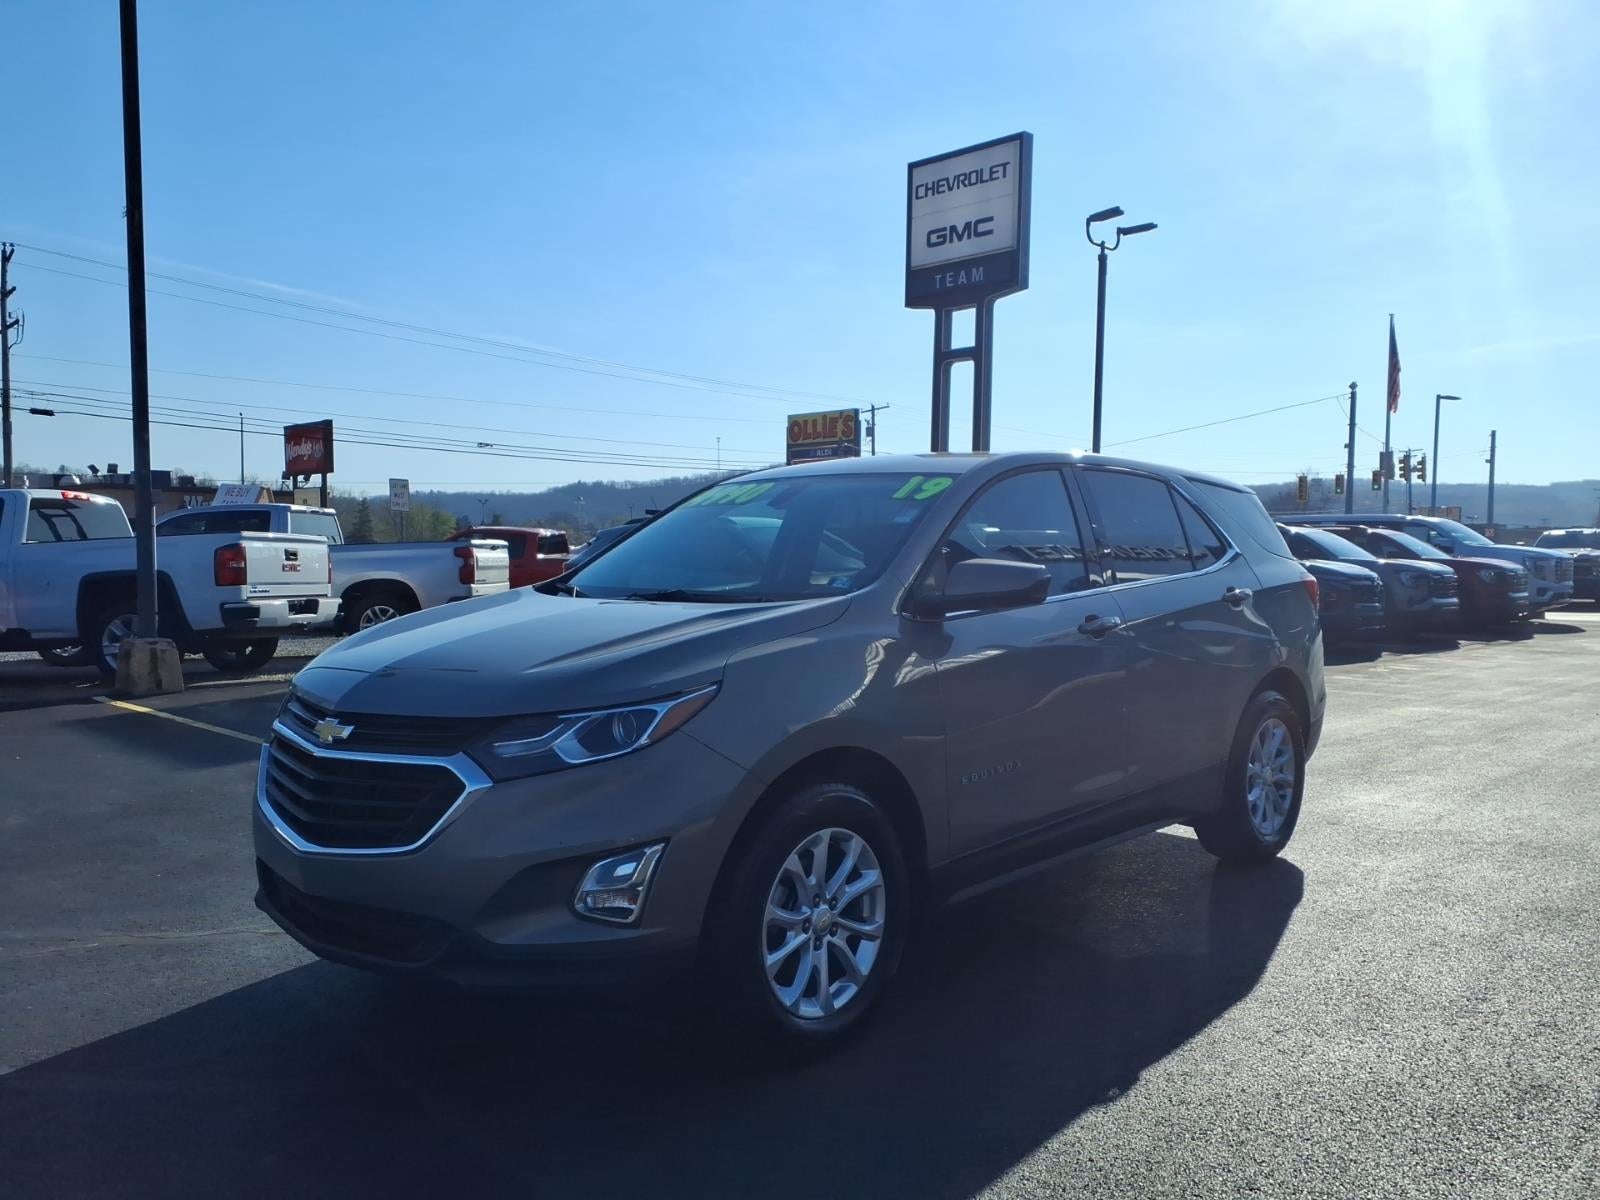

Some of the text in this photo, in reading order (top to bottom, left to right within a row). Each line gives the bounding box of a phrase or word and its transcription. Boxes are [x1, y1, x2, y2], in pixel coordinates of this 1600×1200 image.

[914, 162, 1010, 200] CHEVROLET
[926, 216, 994, 248] GMC
[935, 266, 984, 288] TEAM
[788, 412, 855, 442] OLLIE'S
[816, 448, 833, 456] ALDI
[892, 476, 953, 500] 19
[961, 759, 1024, 785] EQUINOX
